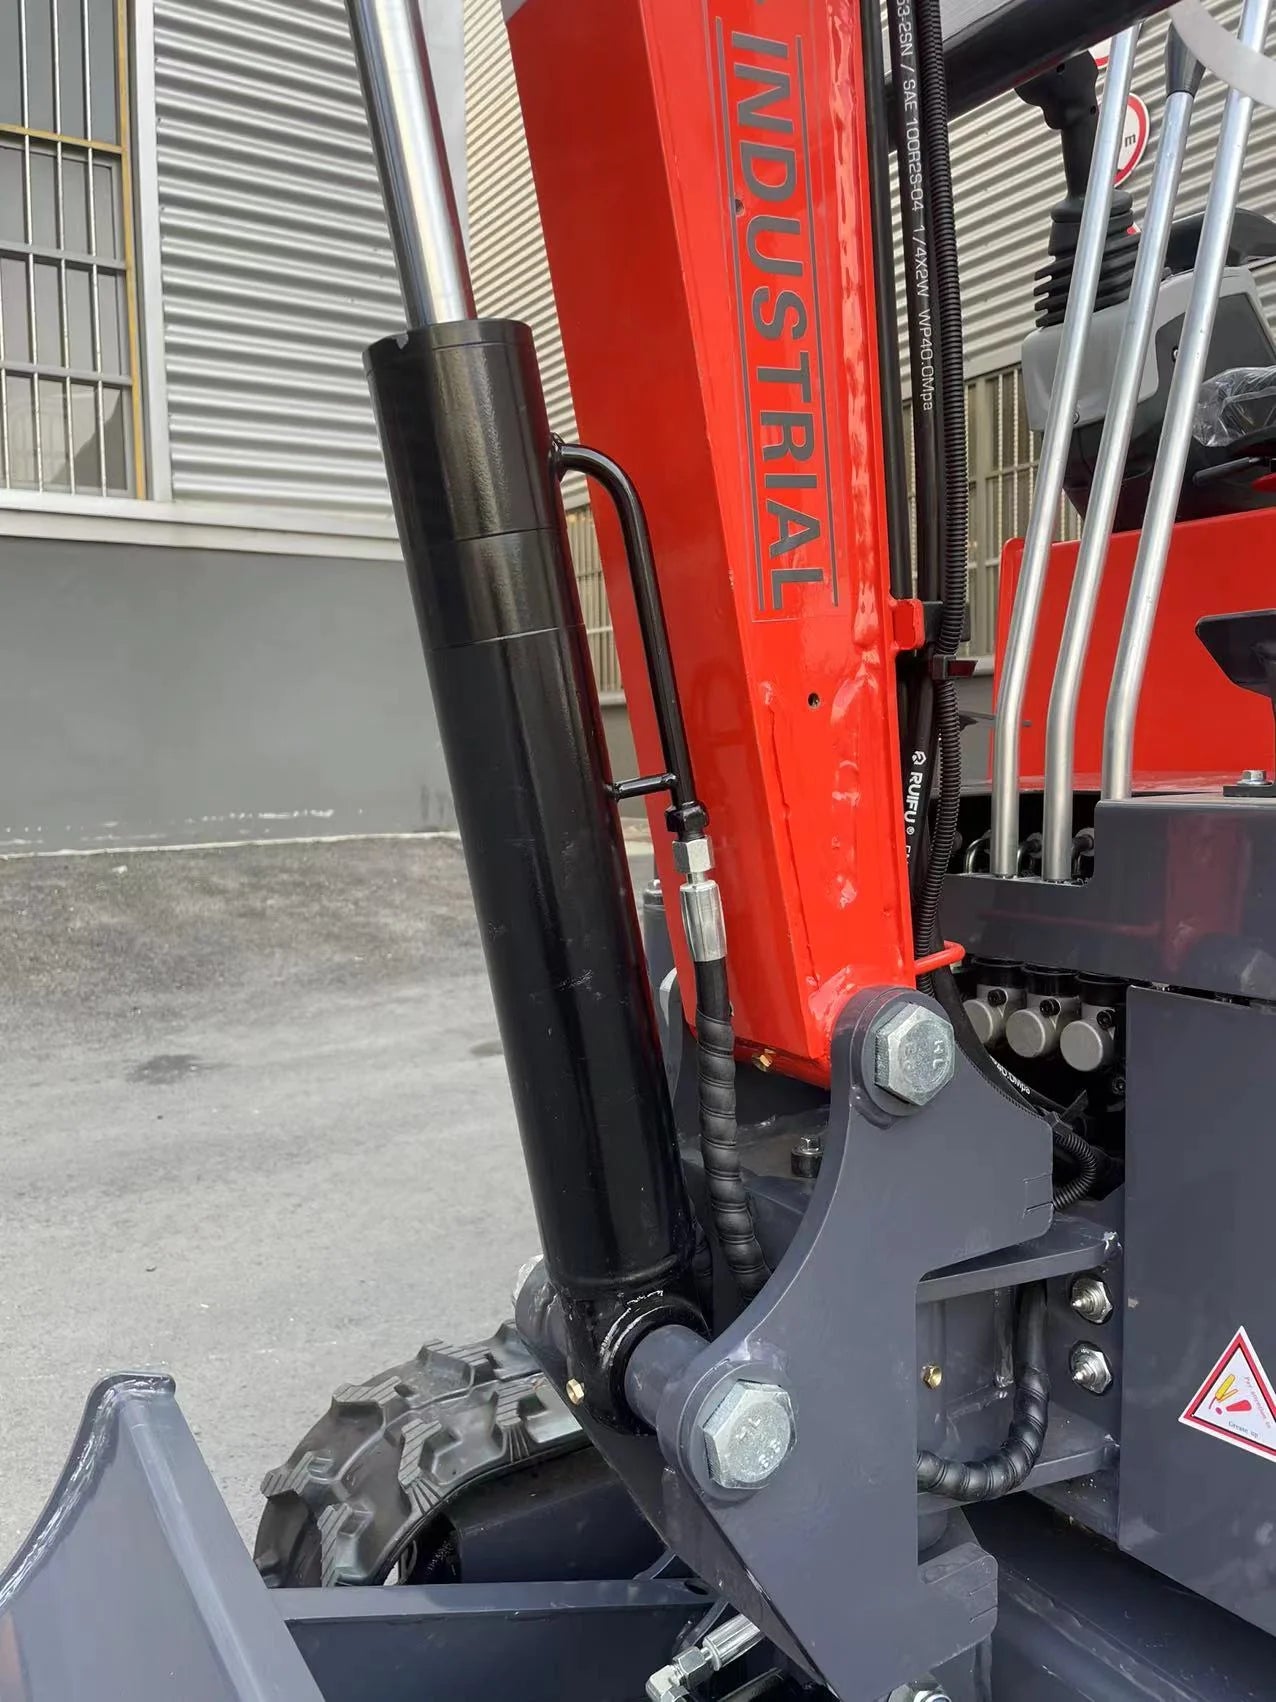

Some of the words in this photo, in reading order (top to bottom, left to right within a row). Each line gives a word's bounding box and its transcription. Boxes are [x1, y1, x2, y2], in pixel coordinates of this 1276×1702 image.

[903, 79, 918, 112] SAE
[906, 117, 924, 212] 100R2S-04
[912, 224, 930, 297] 1/4X2W
[731, 30, 824, 610] INDUSTRIAL
[918, 308, 935, 411] WP40.0Mpa
[904, 771, 923, 823] RUIFU
